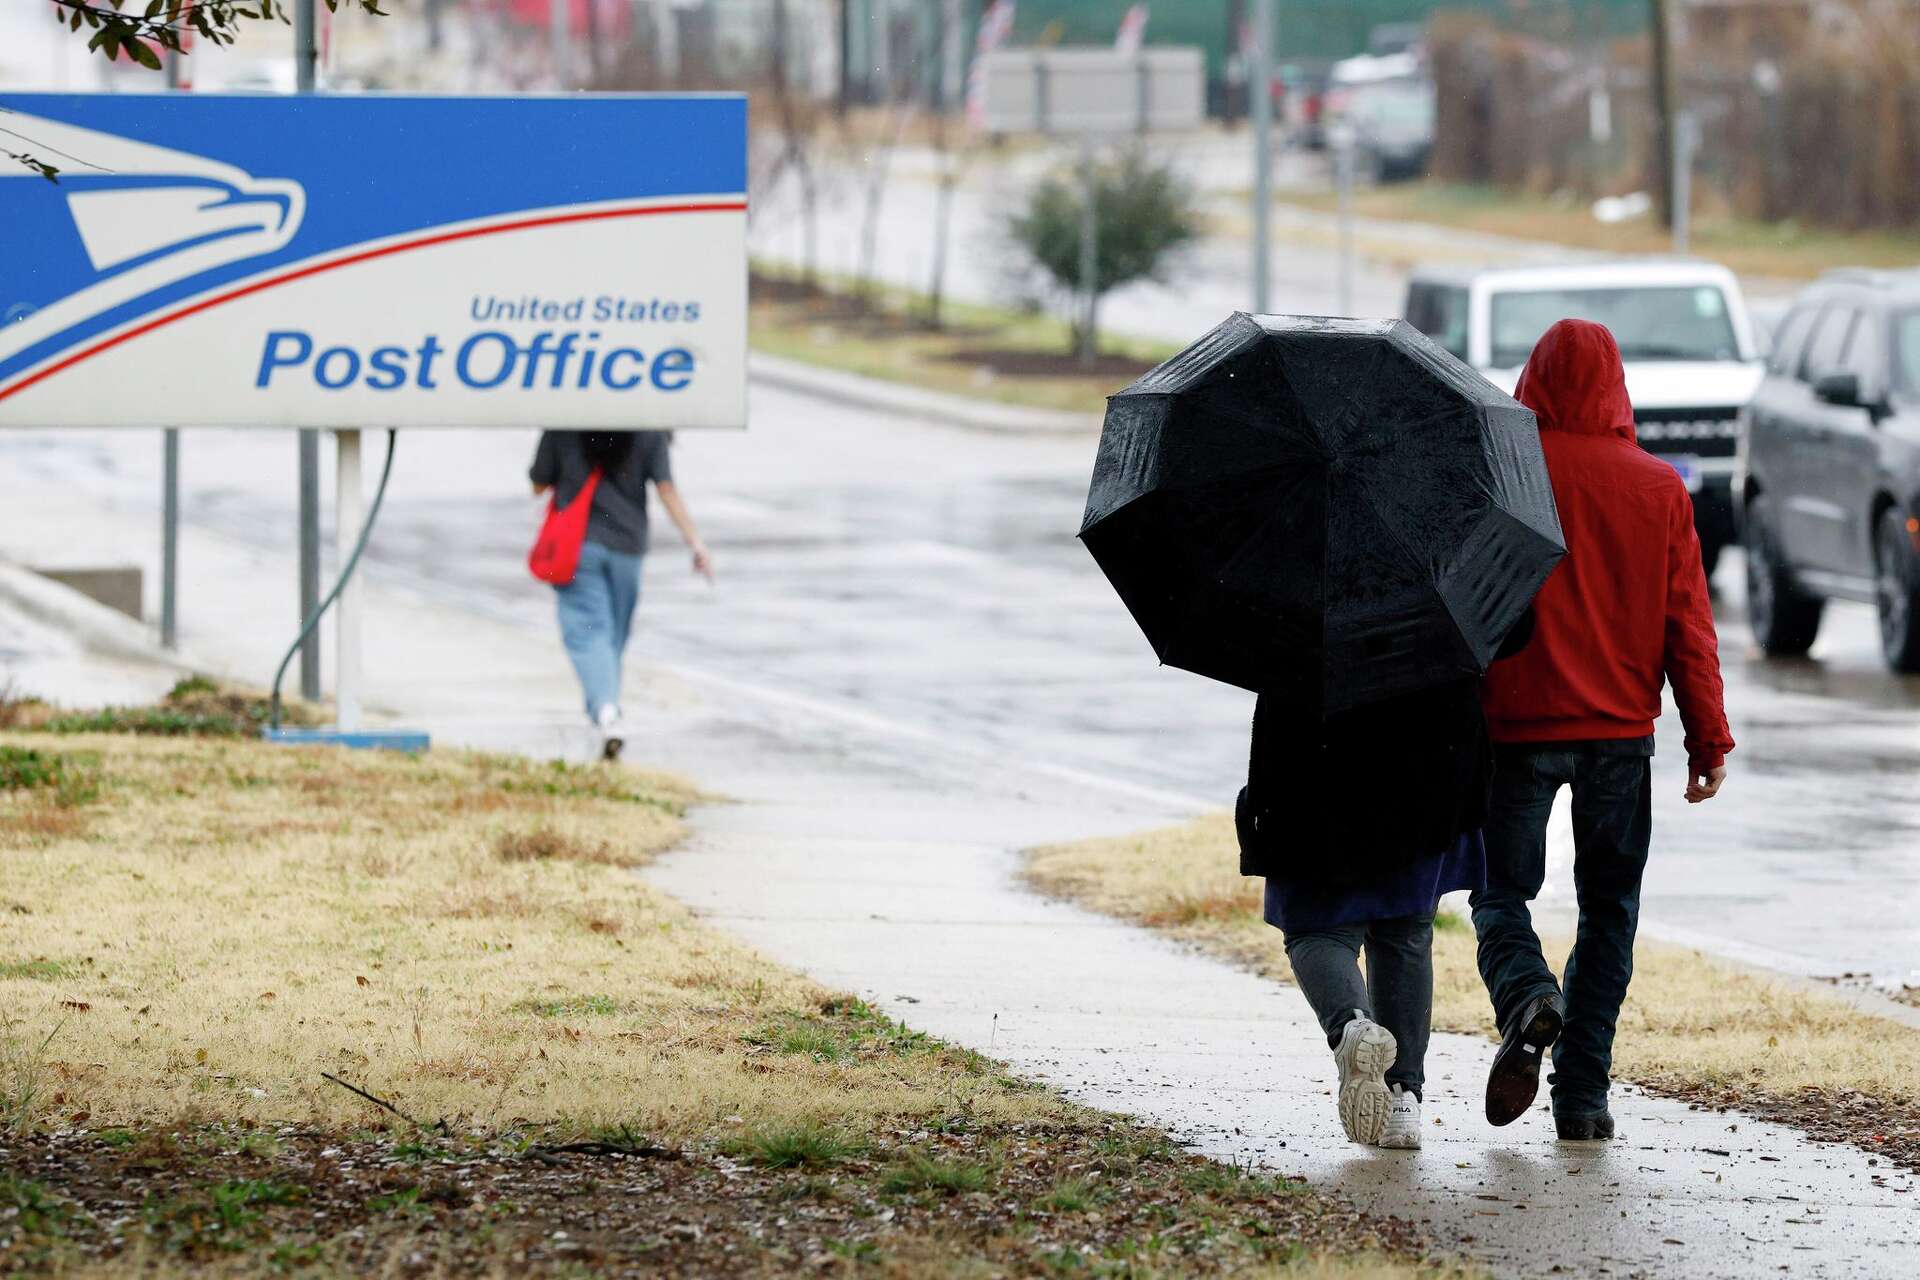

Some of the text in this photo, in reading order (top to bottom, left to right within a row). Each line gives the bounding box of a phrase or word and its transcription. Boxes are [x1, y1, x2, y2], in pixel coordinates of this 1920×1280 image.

[470, 297, 701, 321] United States
[255, 329, 696, 393] Post Office
